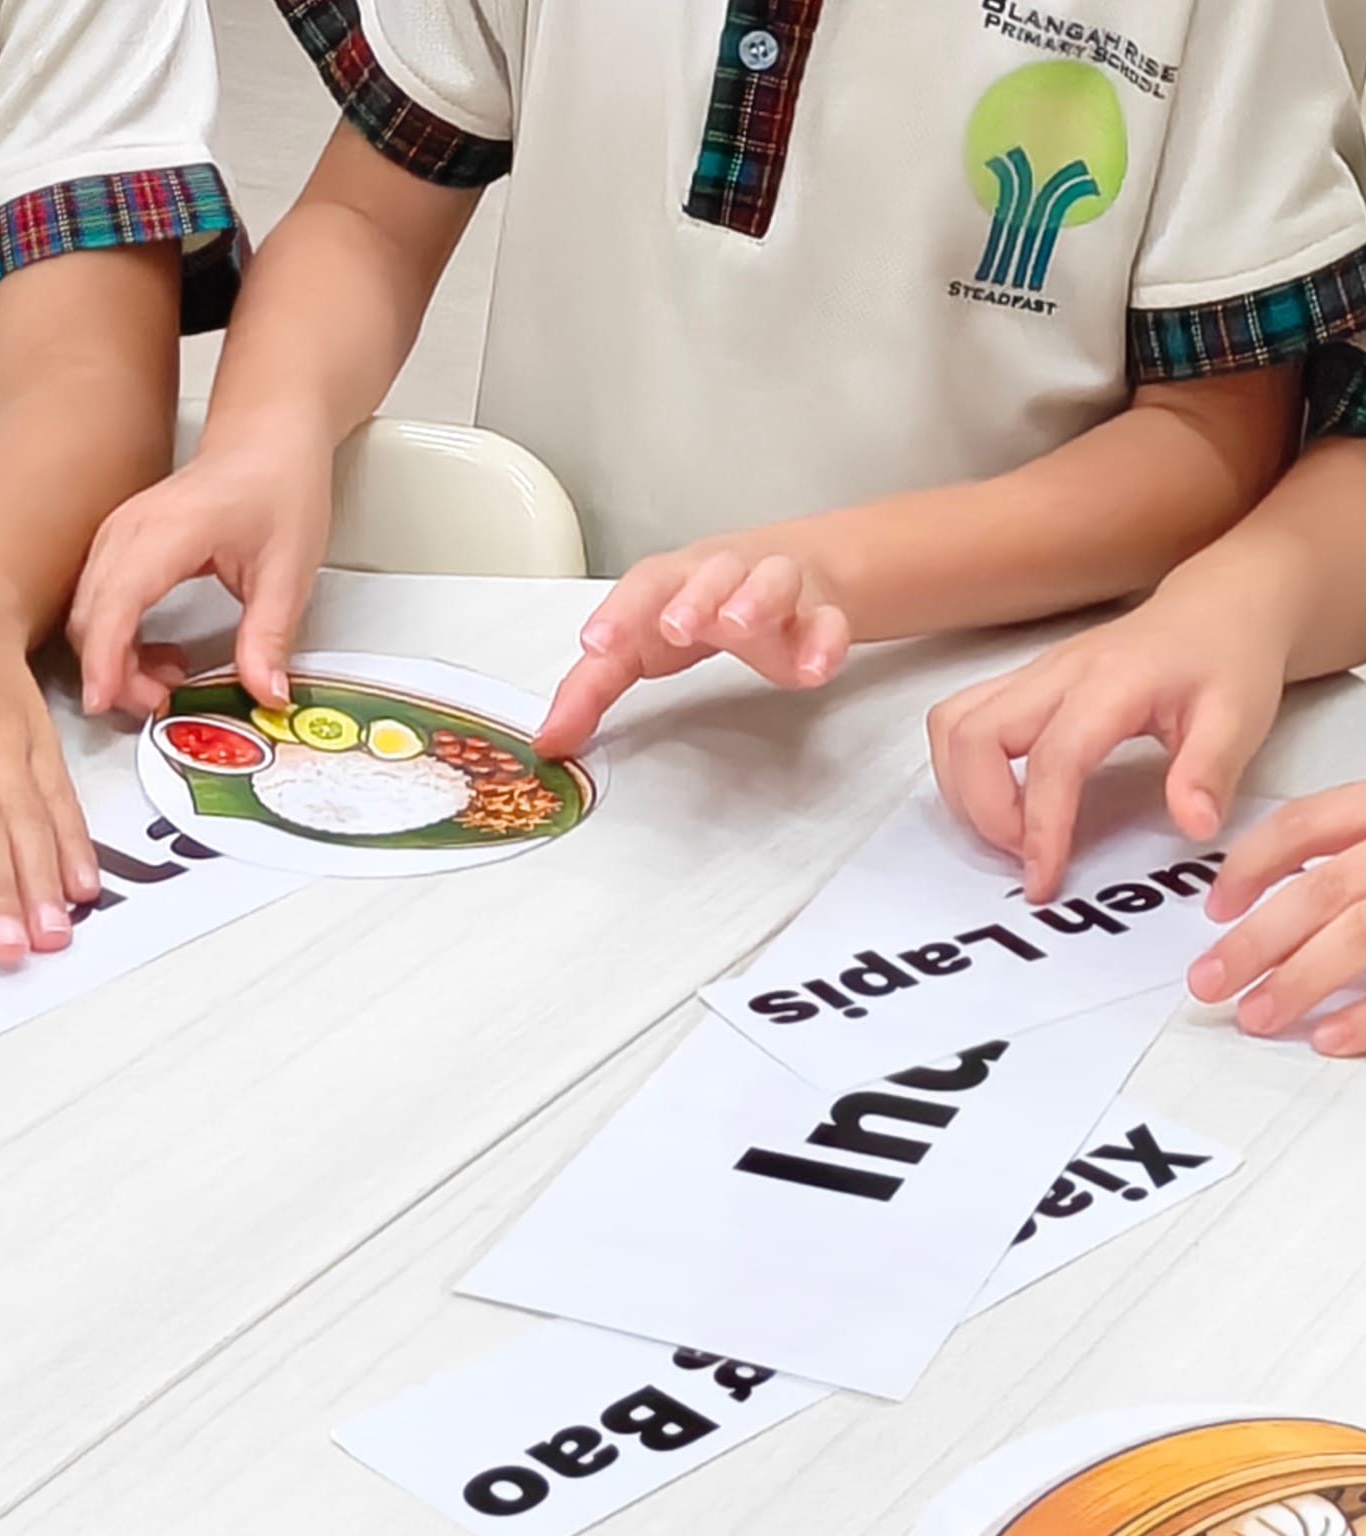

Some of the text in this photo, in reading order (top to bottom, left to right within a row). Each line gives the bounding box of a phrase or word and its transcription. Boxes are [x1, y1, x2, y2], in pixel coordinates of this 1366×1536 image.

[1124, 39, 1179, 84] RISE
[747, 851, 1227, 1025] ueh Lapis
[462, 1384, 720, 1517] Bao
